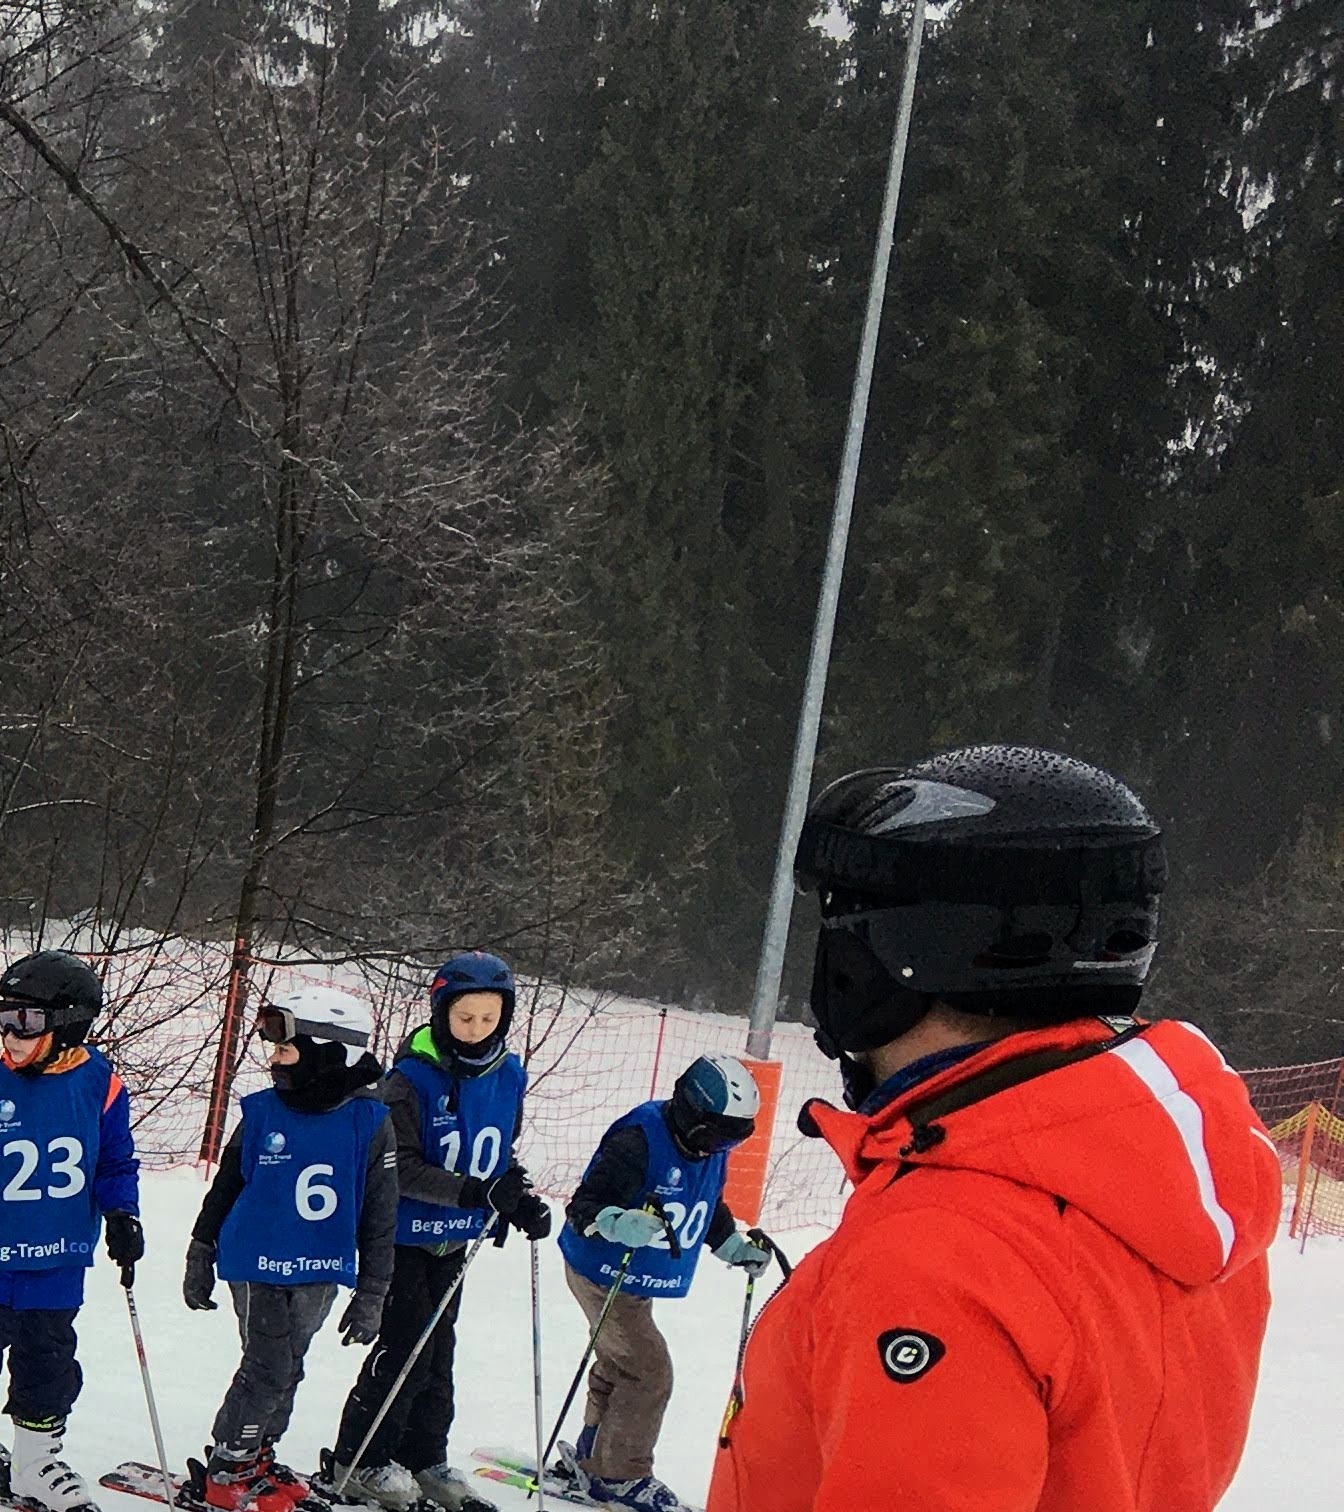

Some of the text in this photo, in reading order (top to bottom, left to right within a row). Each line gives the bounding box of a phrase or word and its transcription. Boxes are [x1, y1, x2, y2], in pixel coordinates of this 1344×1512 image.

[3, 1136, 86, 1201] 23
[440, 1126, 502, 1181] 10
[295, 1163, 338, 1221] 6
[648, 1201, 708, 1249] 20
